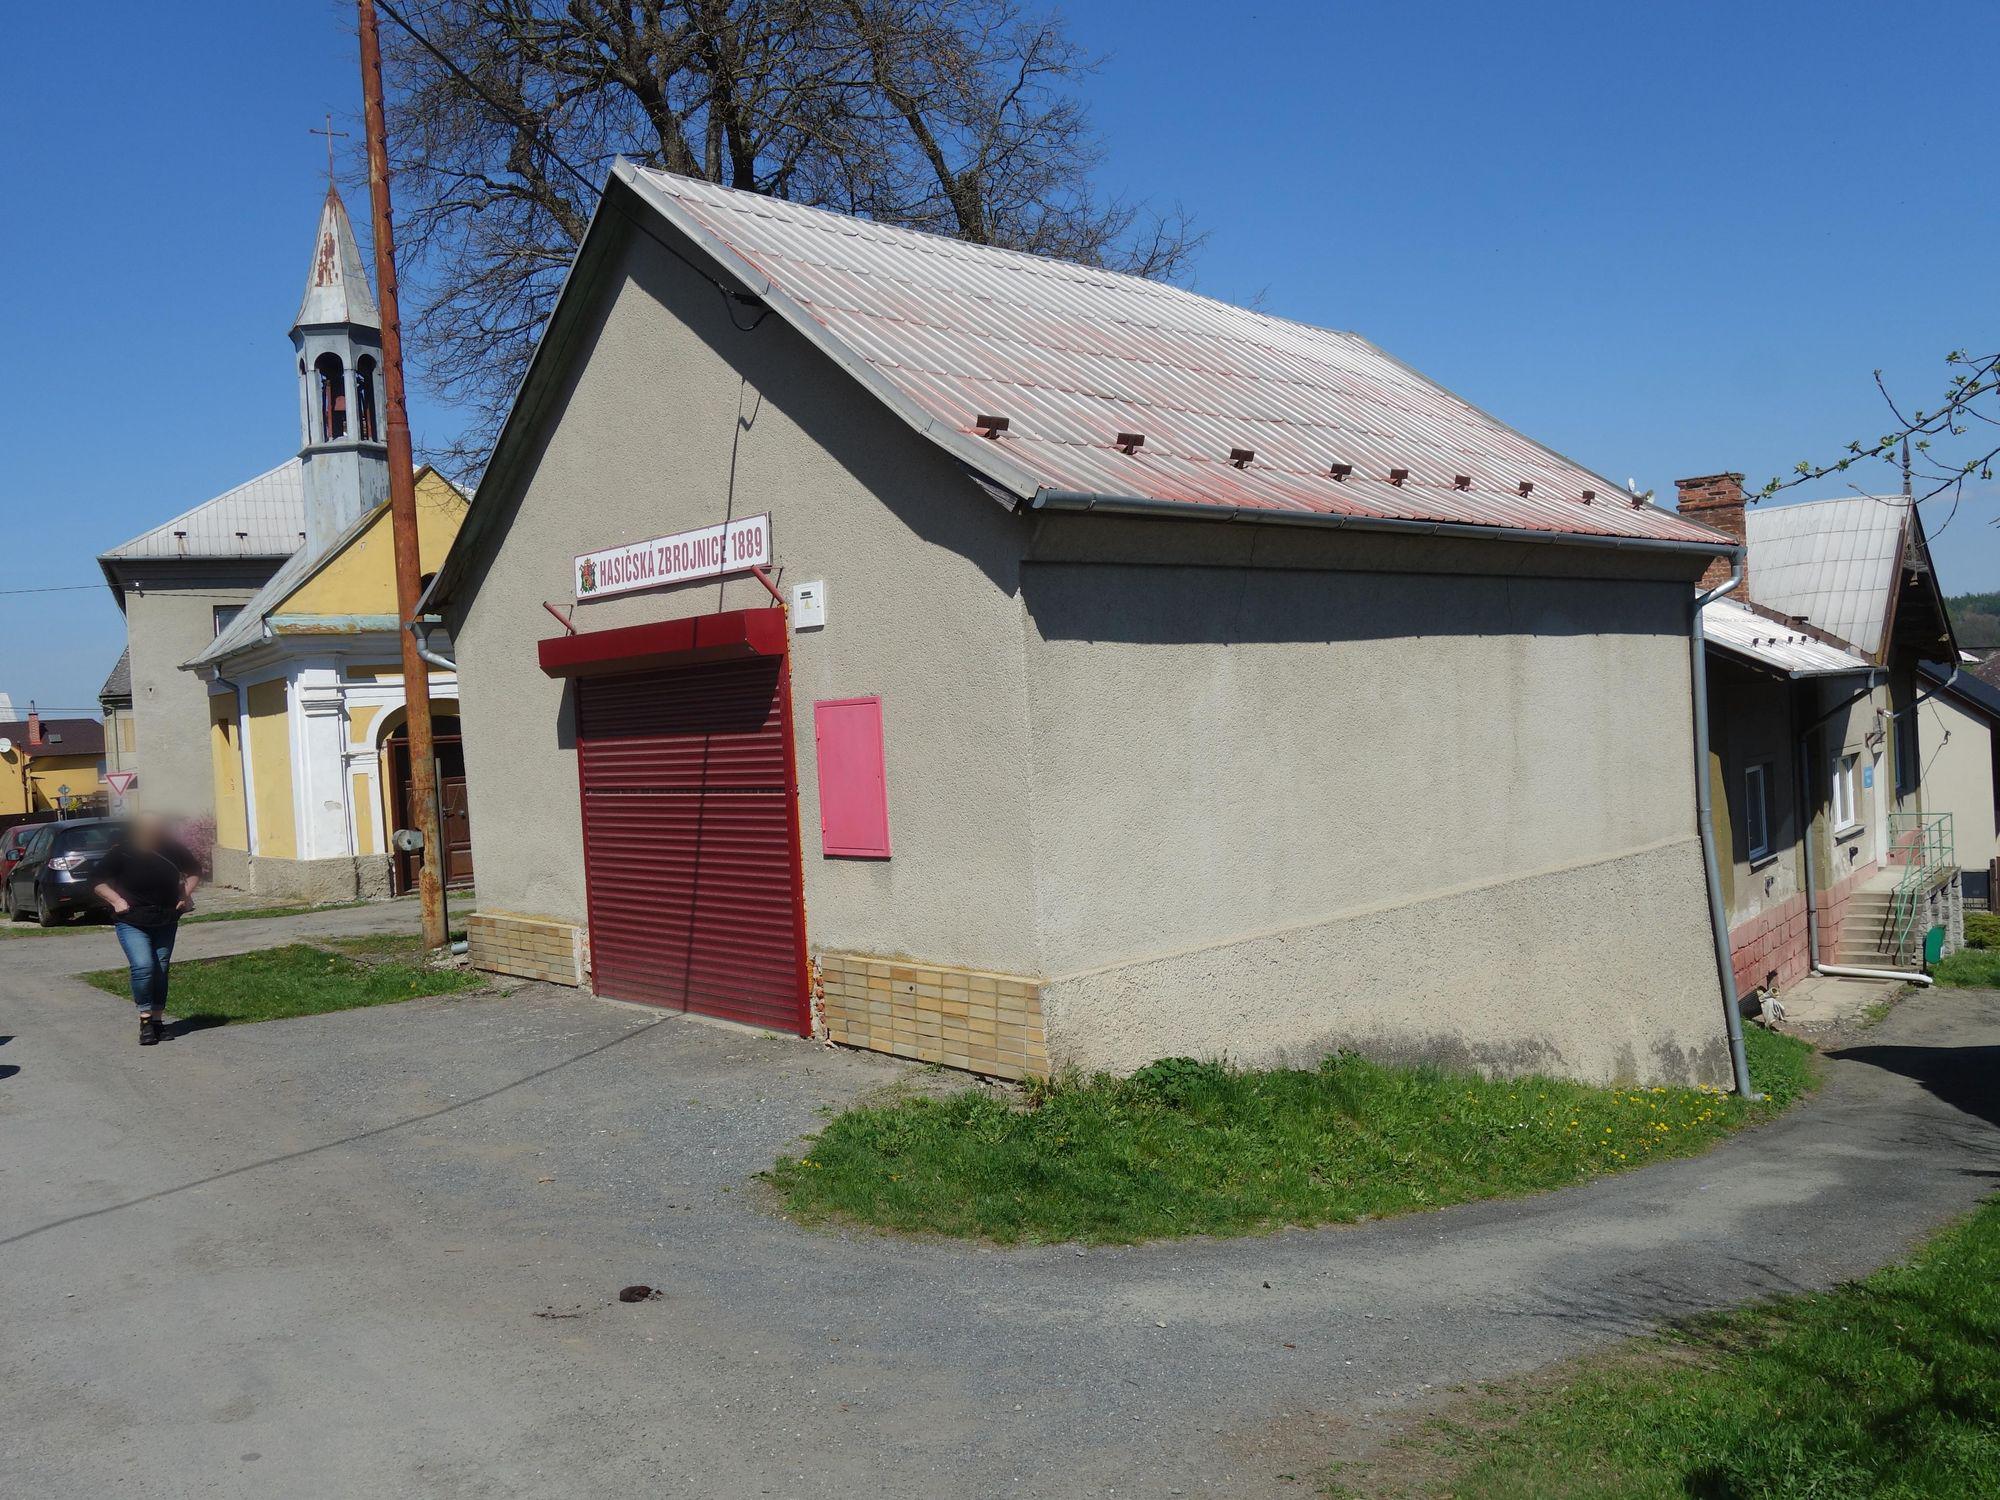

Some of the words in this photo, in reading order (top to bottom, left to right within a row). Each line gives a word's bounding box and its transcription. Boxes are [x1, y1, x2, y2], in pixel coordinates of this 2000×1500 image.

[600, 544, 655, 587] HASIČSKÁ
[658, 534, 727, 575] ZBROJNICE
[732, 527, 763, 561] 1889
